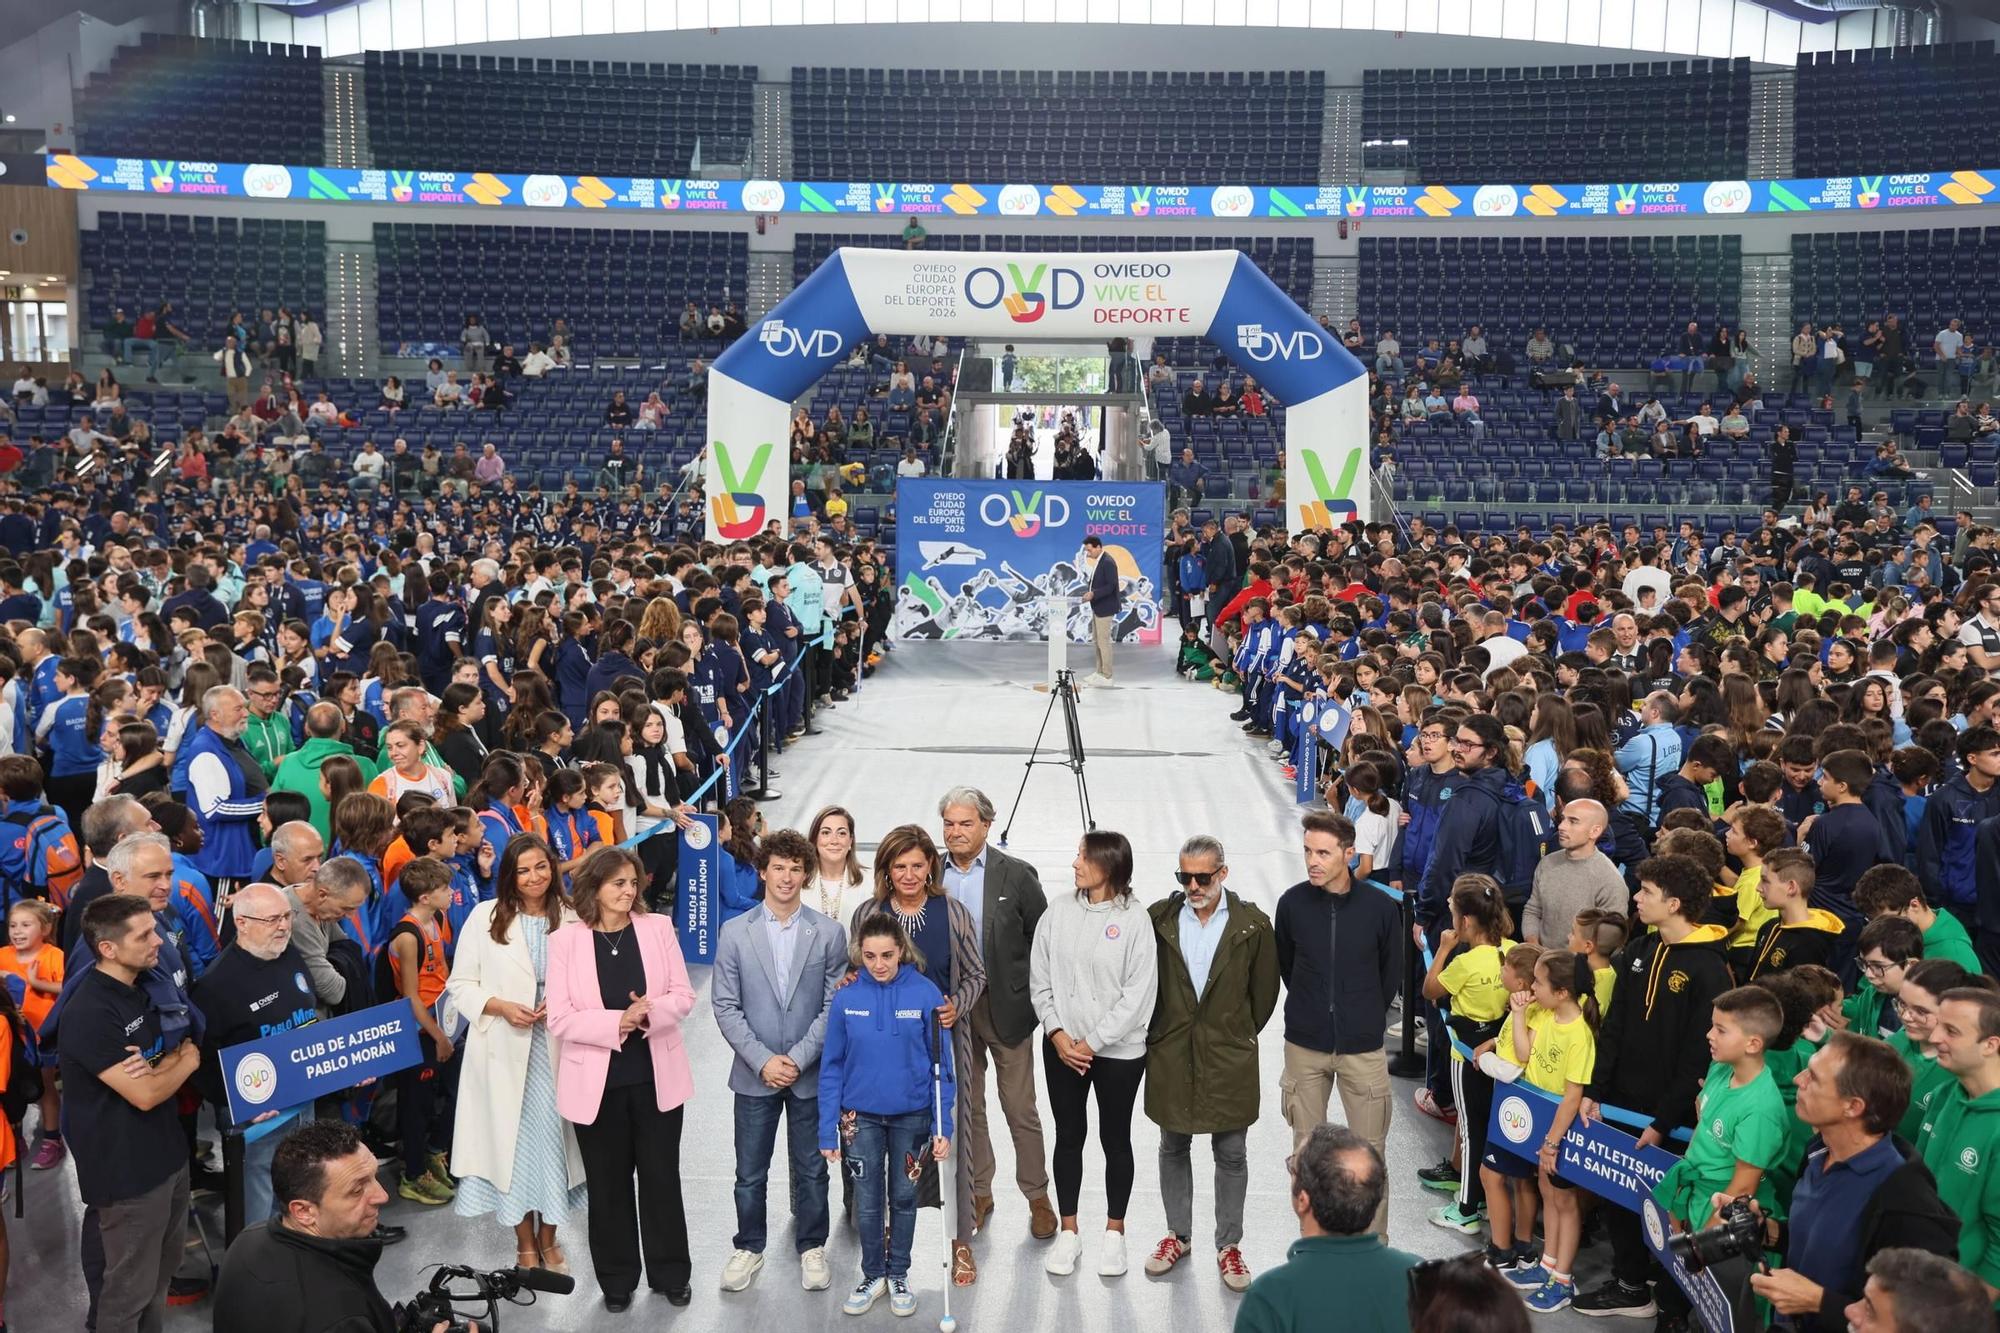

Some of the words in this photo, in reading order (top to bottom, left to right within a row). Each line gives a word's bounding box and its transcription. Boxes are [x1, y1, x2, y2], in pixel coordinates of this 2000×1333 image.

[179, 162, 217, 173] OVIEDO
[180, 173, 202, 182] VIVE
[204, 174, 216, 183] EL
[419, 172, 454, 181] OVIEDO
[1890, 174, 1930, 184] OVIEDO
[180, 184, 227, 194] DEPORTE
[420, 183, 441, 191] VIVE
[442, 183, 452, 192] EL
[686, 181, 719, 189] OVIEDO
[902, 184, 934, 193] OVIEDO
[1643, 184, 1679, 192] OVIEDO
[1890, 186, 1912, 194] VIVE
[1915, 185, 1926, 194] EL
[1156, 187, 1189, 195] OVIEDO
[1373, 187, 1407, 195] OVIEDO
[420, 193, 463, 202] DEPORTE
[1888, 196, 1938, 206] DEPORTE
[686, 201, 728, 209] DEPORTE
[1642, 204, 1687, 213] DEPORTE
[1372, 207, 1414, 215] DEPORTE
[913, 264, 956, 273] OVIEDO
[1094, 264, 1171, 278] OVIEDO
[914, 275, 956, 283] CIUDAD
[906, 285, 956, 295] EUROPEA
[1094, 285, 1139, 301] VIVE
[1145, 285, 1167, 301] EL
[884, 296, 904, 305] DEL
[908, 296, 956, 307] DEPORTE
[929, 308, 956, 318] 2026
[1094, 308, 1190, 323] DEPORTE
[766, 327, 842, 357] OVD
[1246, 332, 1322, 361] OVD
[1087, 496, 1135, 506] OVIEDO
[928, 508, 965, 516] EUROPEA
[1087, 510, 1115, 520] VIVE
[1119, 510, 1132, 520] EL
[945, 525, 965, 533] 2026
[1086, 525, 1147, 535] DEPORTE
[689, 879, 696, 894] DE
[689, 896, 698, 932] FÚTBOL
[291, 1043, 324, 1063] CLUB
[329, 1036, 345, 1051] DE
[349, 1020, 402, 1046] AJEDREZ
[306, 1056, 348, 1079] PABLO
[351, 1041, 395, 1066] MORÁN
[1587, 1140, 1665, 1182] ATLETISMO
[1564, 1148, 1581, 1165] LA
[1584, 1160, 1639, 1192] SANTIN
